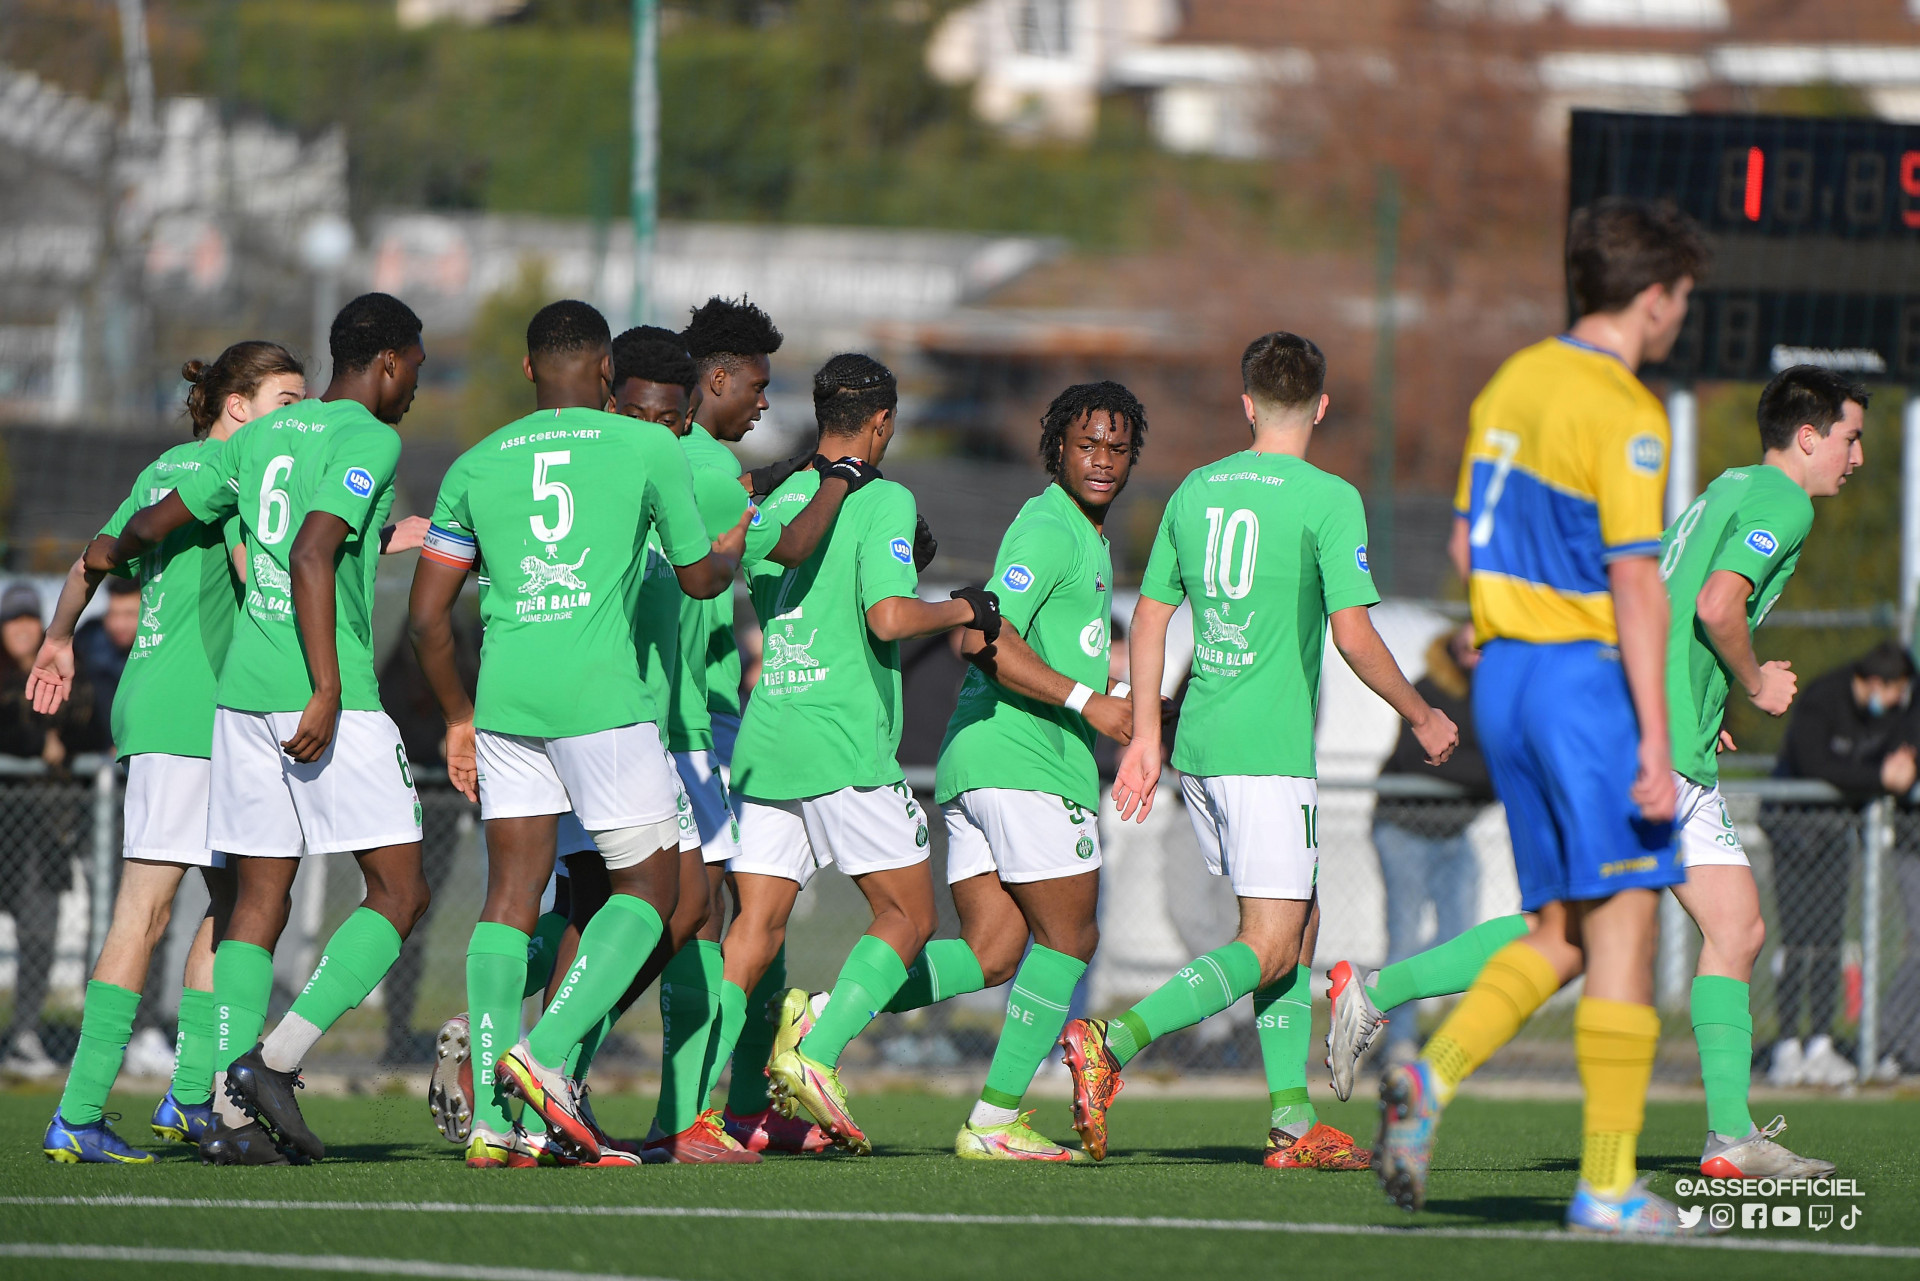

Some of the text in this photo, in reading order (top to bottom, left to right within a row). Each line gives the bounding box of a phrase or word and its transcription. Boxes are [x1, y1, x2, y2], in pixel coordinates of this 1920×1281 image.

[500, 435, 526, 451] ASSE
[350, 472, 371, 490] U19
[1207, 473, 1229, 483] ASSE
[1469, 427, 1520, 547] 7
[257, 454, 295, 545] 6
[529, 450, 575, 543] 5
[1203, 507, 1260, 600] 10
[1658, 499, 1707, 582] 8
[1752, 533, 1774, 550] U19
[1008, 569, 1029, 585] U19
[550, 592, 591, 610] BALM
[1196, 643, 1224, 664] TIGER
[788, 668, 826, 683] BALM
[396, 743, 413, 789] 6
[548, 954, 588, 1014] ASSE
[480, 1012, 494, 1085] ASSE
